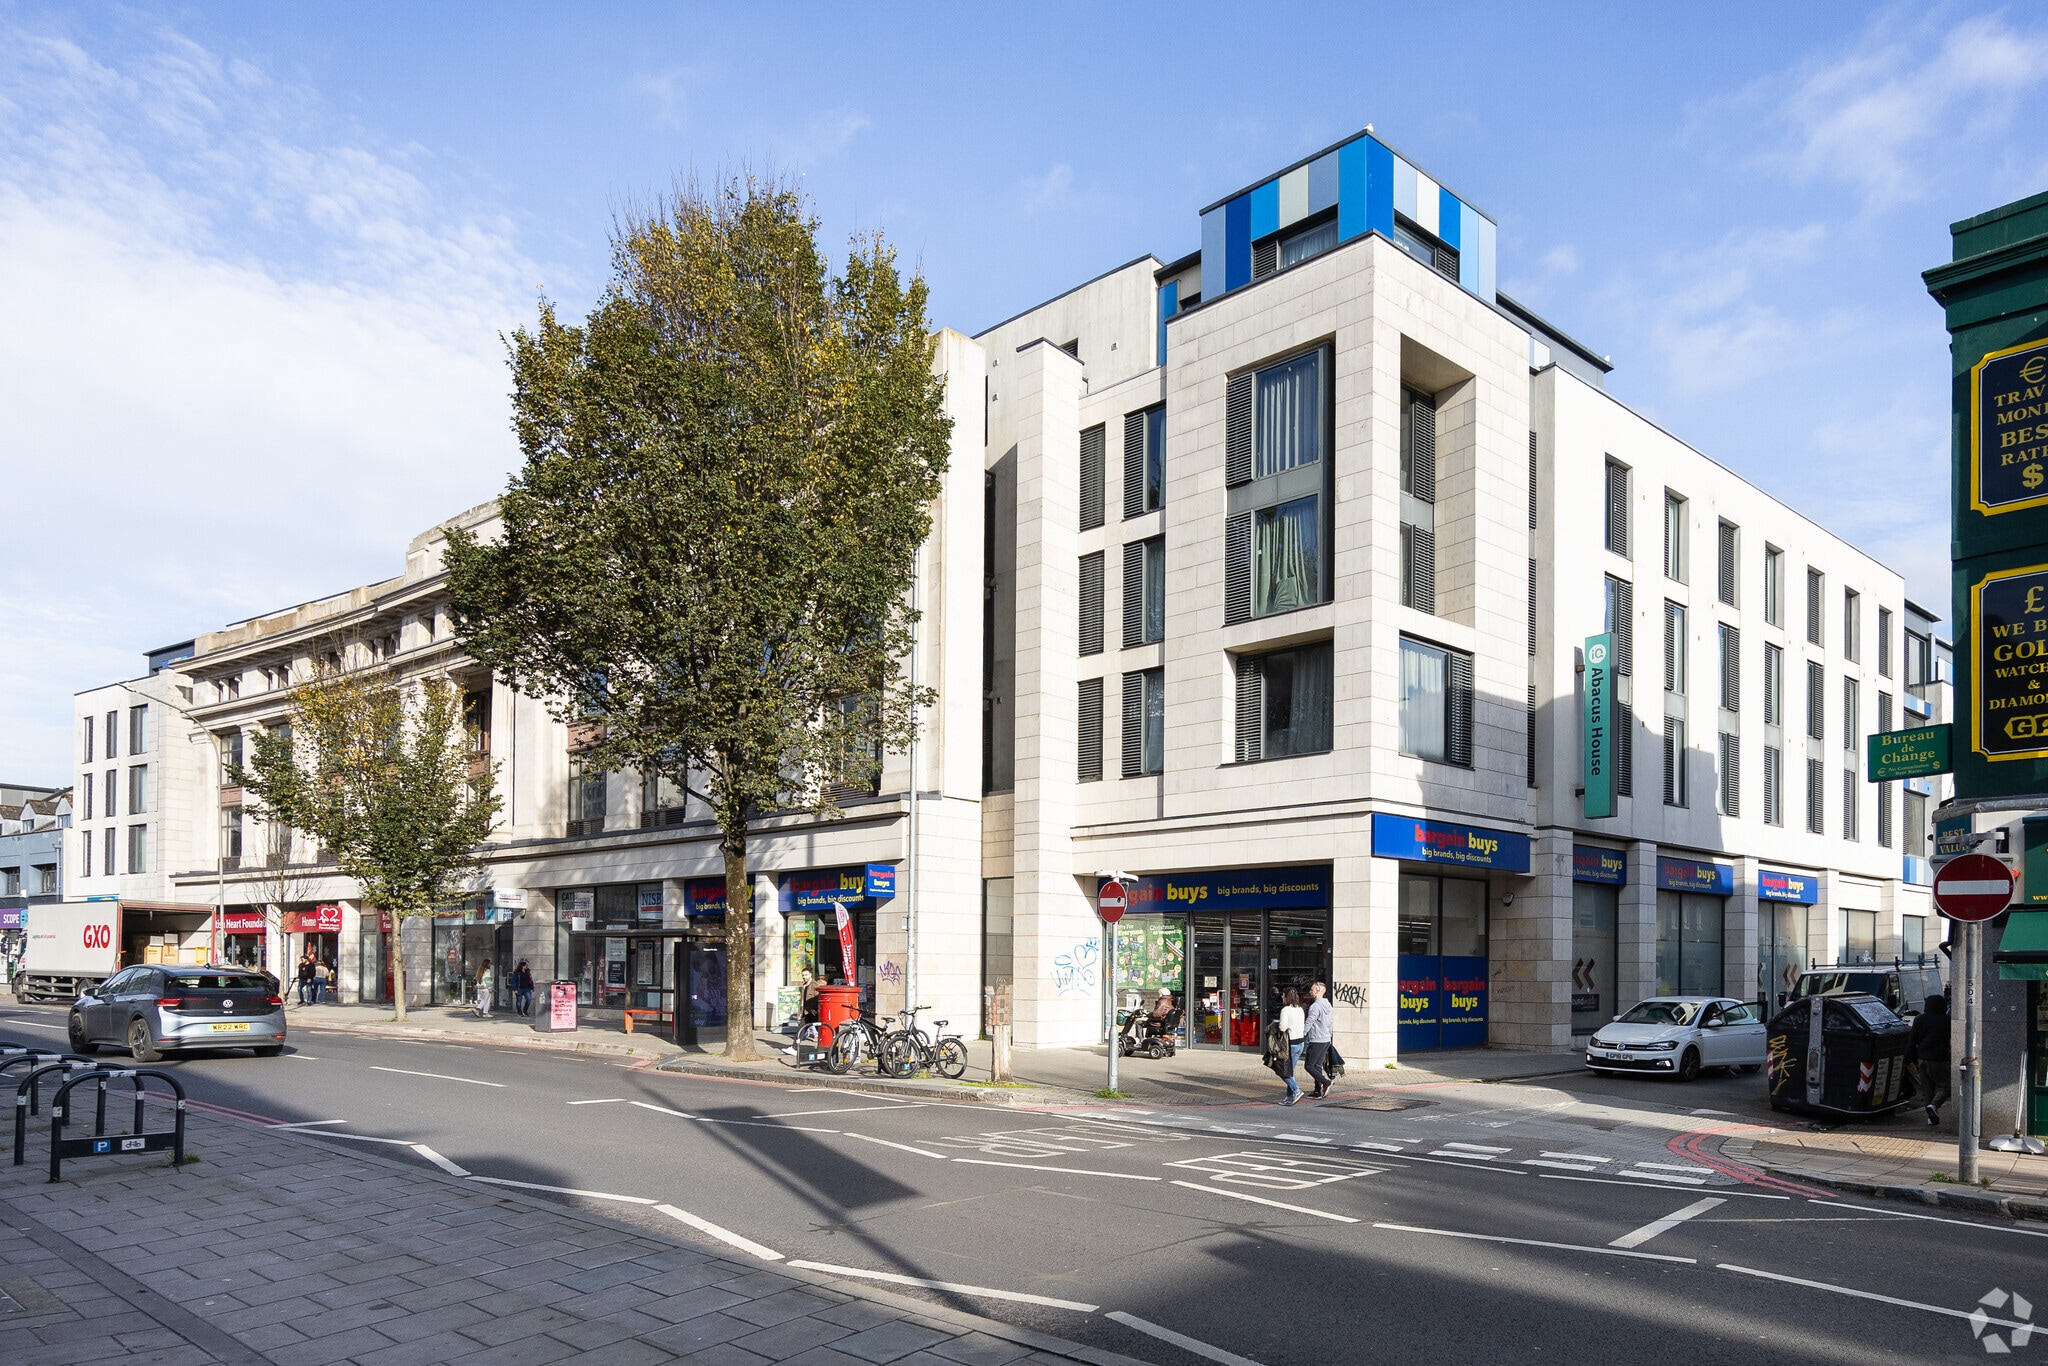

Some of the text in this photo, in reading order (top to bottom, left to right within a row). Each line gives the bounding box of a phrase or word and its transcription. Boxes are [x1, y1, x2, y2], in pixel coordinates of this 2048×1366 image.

[2022, 463, 2044, 489] $
[2024, 586, 2045, 614] £
[1993, 619, 2048, 639] WE B
[2028, 680, 2041, 690] &
[1592, 667, 1603, 776] Abacus House
[1882, 731, 1935, 746] Bureau
[1882, 750, 1935, 764] Change
[1901, 744, 1915, 753] de
[1415, 824, 1498, 855] bargain buys
[1422, 846, 1492, 863] big brands, big discounts
[1572, 852, 1623, 872] rgain buys
[1592, 869, 1600, 878] big
[1664, 862, 1716, 883] bargain buys
[690, 884, 727, 902] bargai
[791, 872, 866, 897] bargain buy
[1762, 873, 1804, 894] bargain buys
[641, 892, 663, 906] NISB
[797, 896, 807, 907] big
[807, 895, 826, 906] brands,
[838, 893, 864, 903] discounts
[1127, 883, 1319, 906] gain buys big brands, big discounts
[696, 903, 704, 911] big
[3, 913, 20, 924] SCOPE
[226, 919, 242, 928] Heart
[301, 916, 316, 927] Home
[83, 924, 111, 949] GXO
[1398, 976, 1437, 995] argain
[1443, 976, 1485, 995] bargain
[1400, 993, 1429, 1013] buys
[1451, 993, 1478, 1012] buys
[98, 1142, 108, 1151] P
